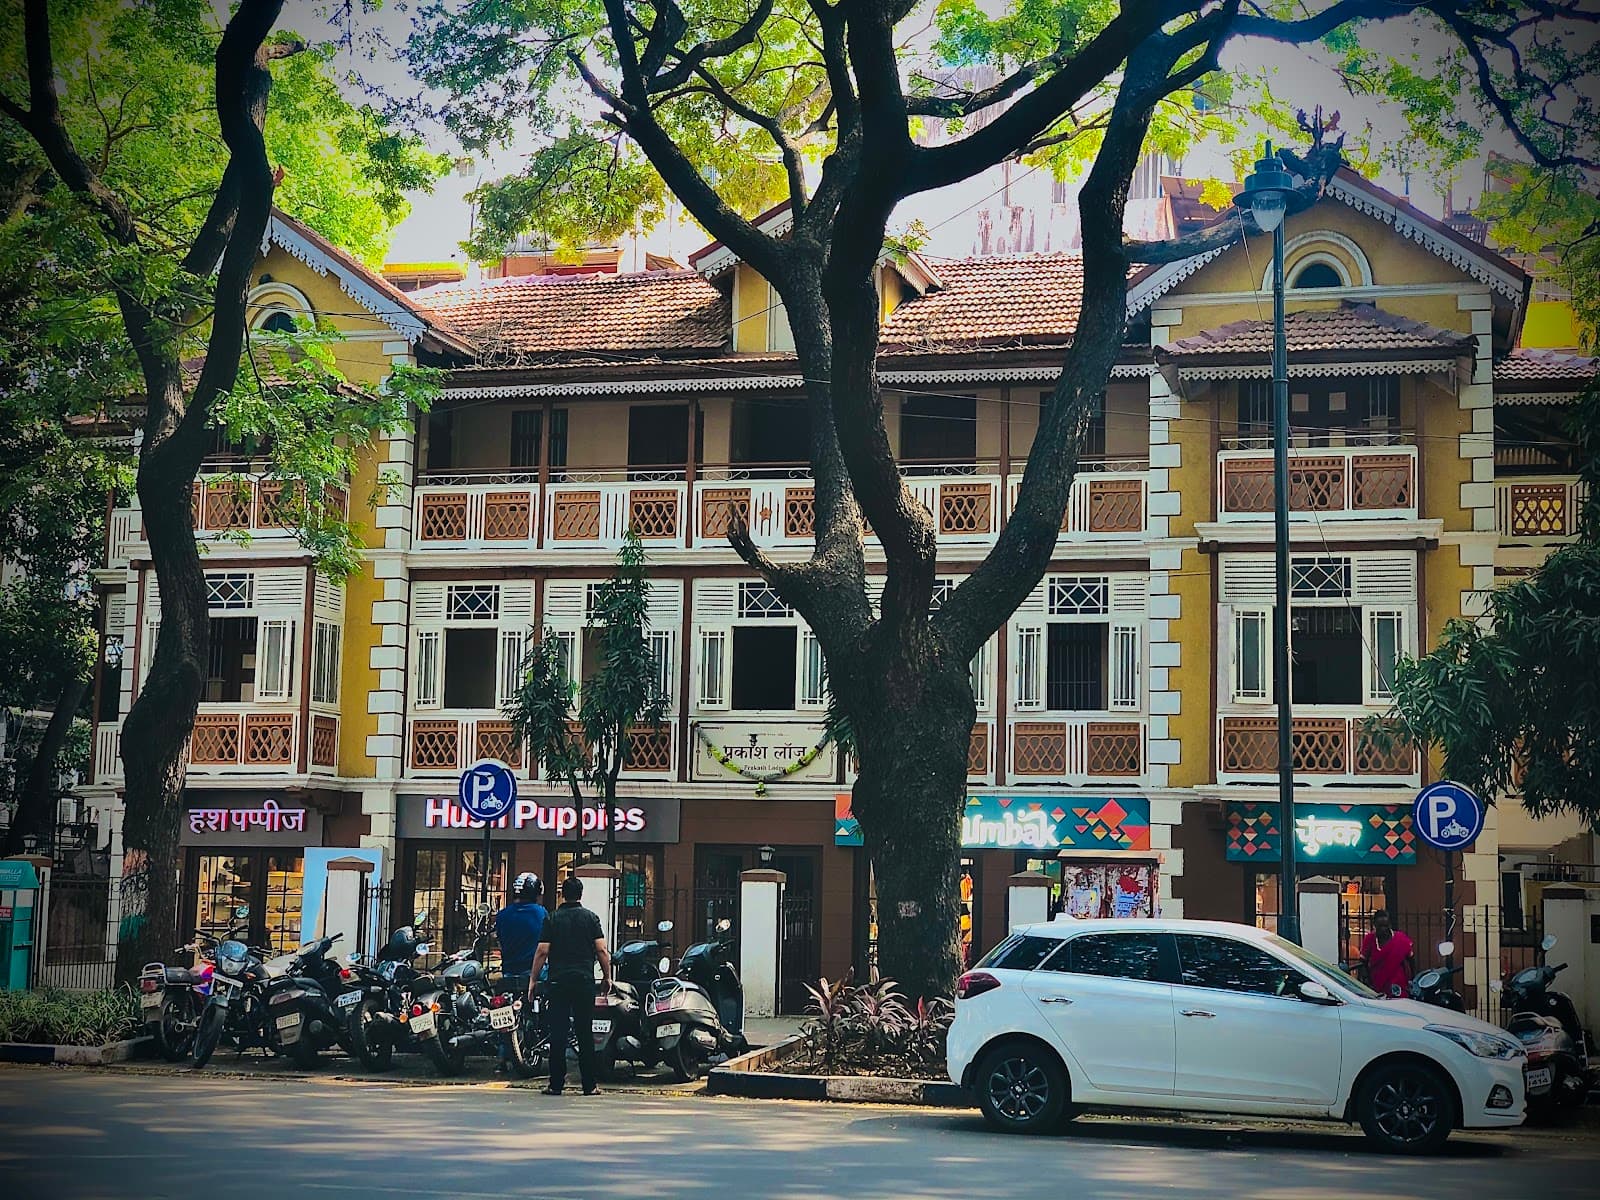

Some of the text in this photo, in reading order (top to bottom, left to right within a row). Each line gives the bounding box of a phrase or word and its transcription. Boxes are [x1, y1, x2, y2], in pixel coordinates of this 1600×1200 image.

[723, 743, 807, 760] प्रकाश लॉज
[472, 771, 495, 809] P
[189, 800, 306, 834] हश पप्पीज
[514, 800, 646, 836] Puppies
[1429, 796, 1456, 838] P
